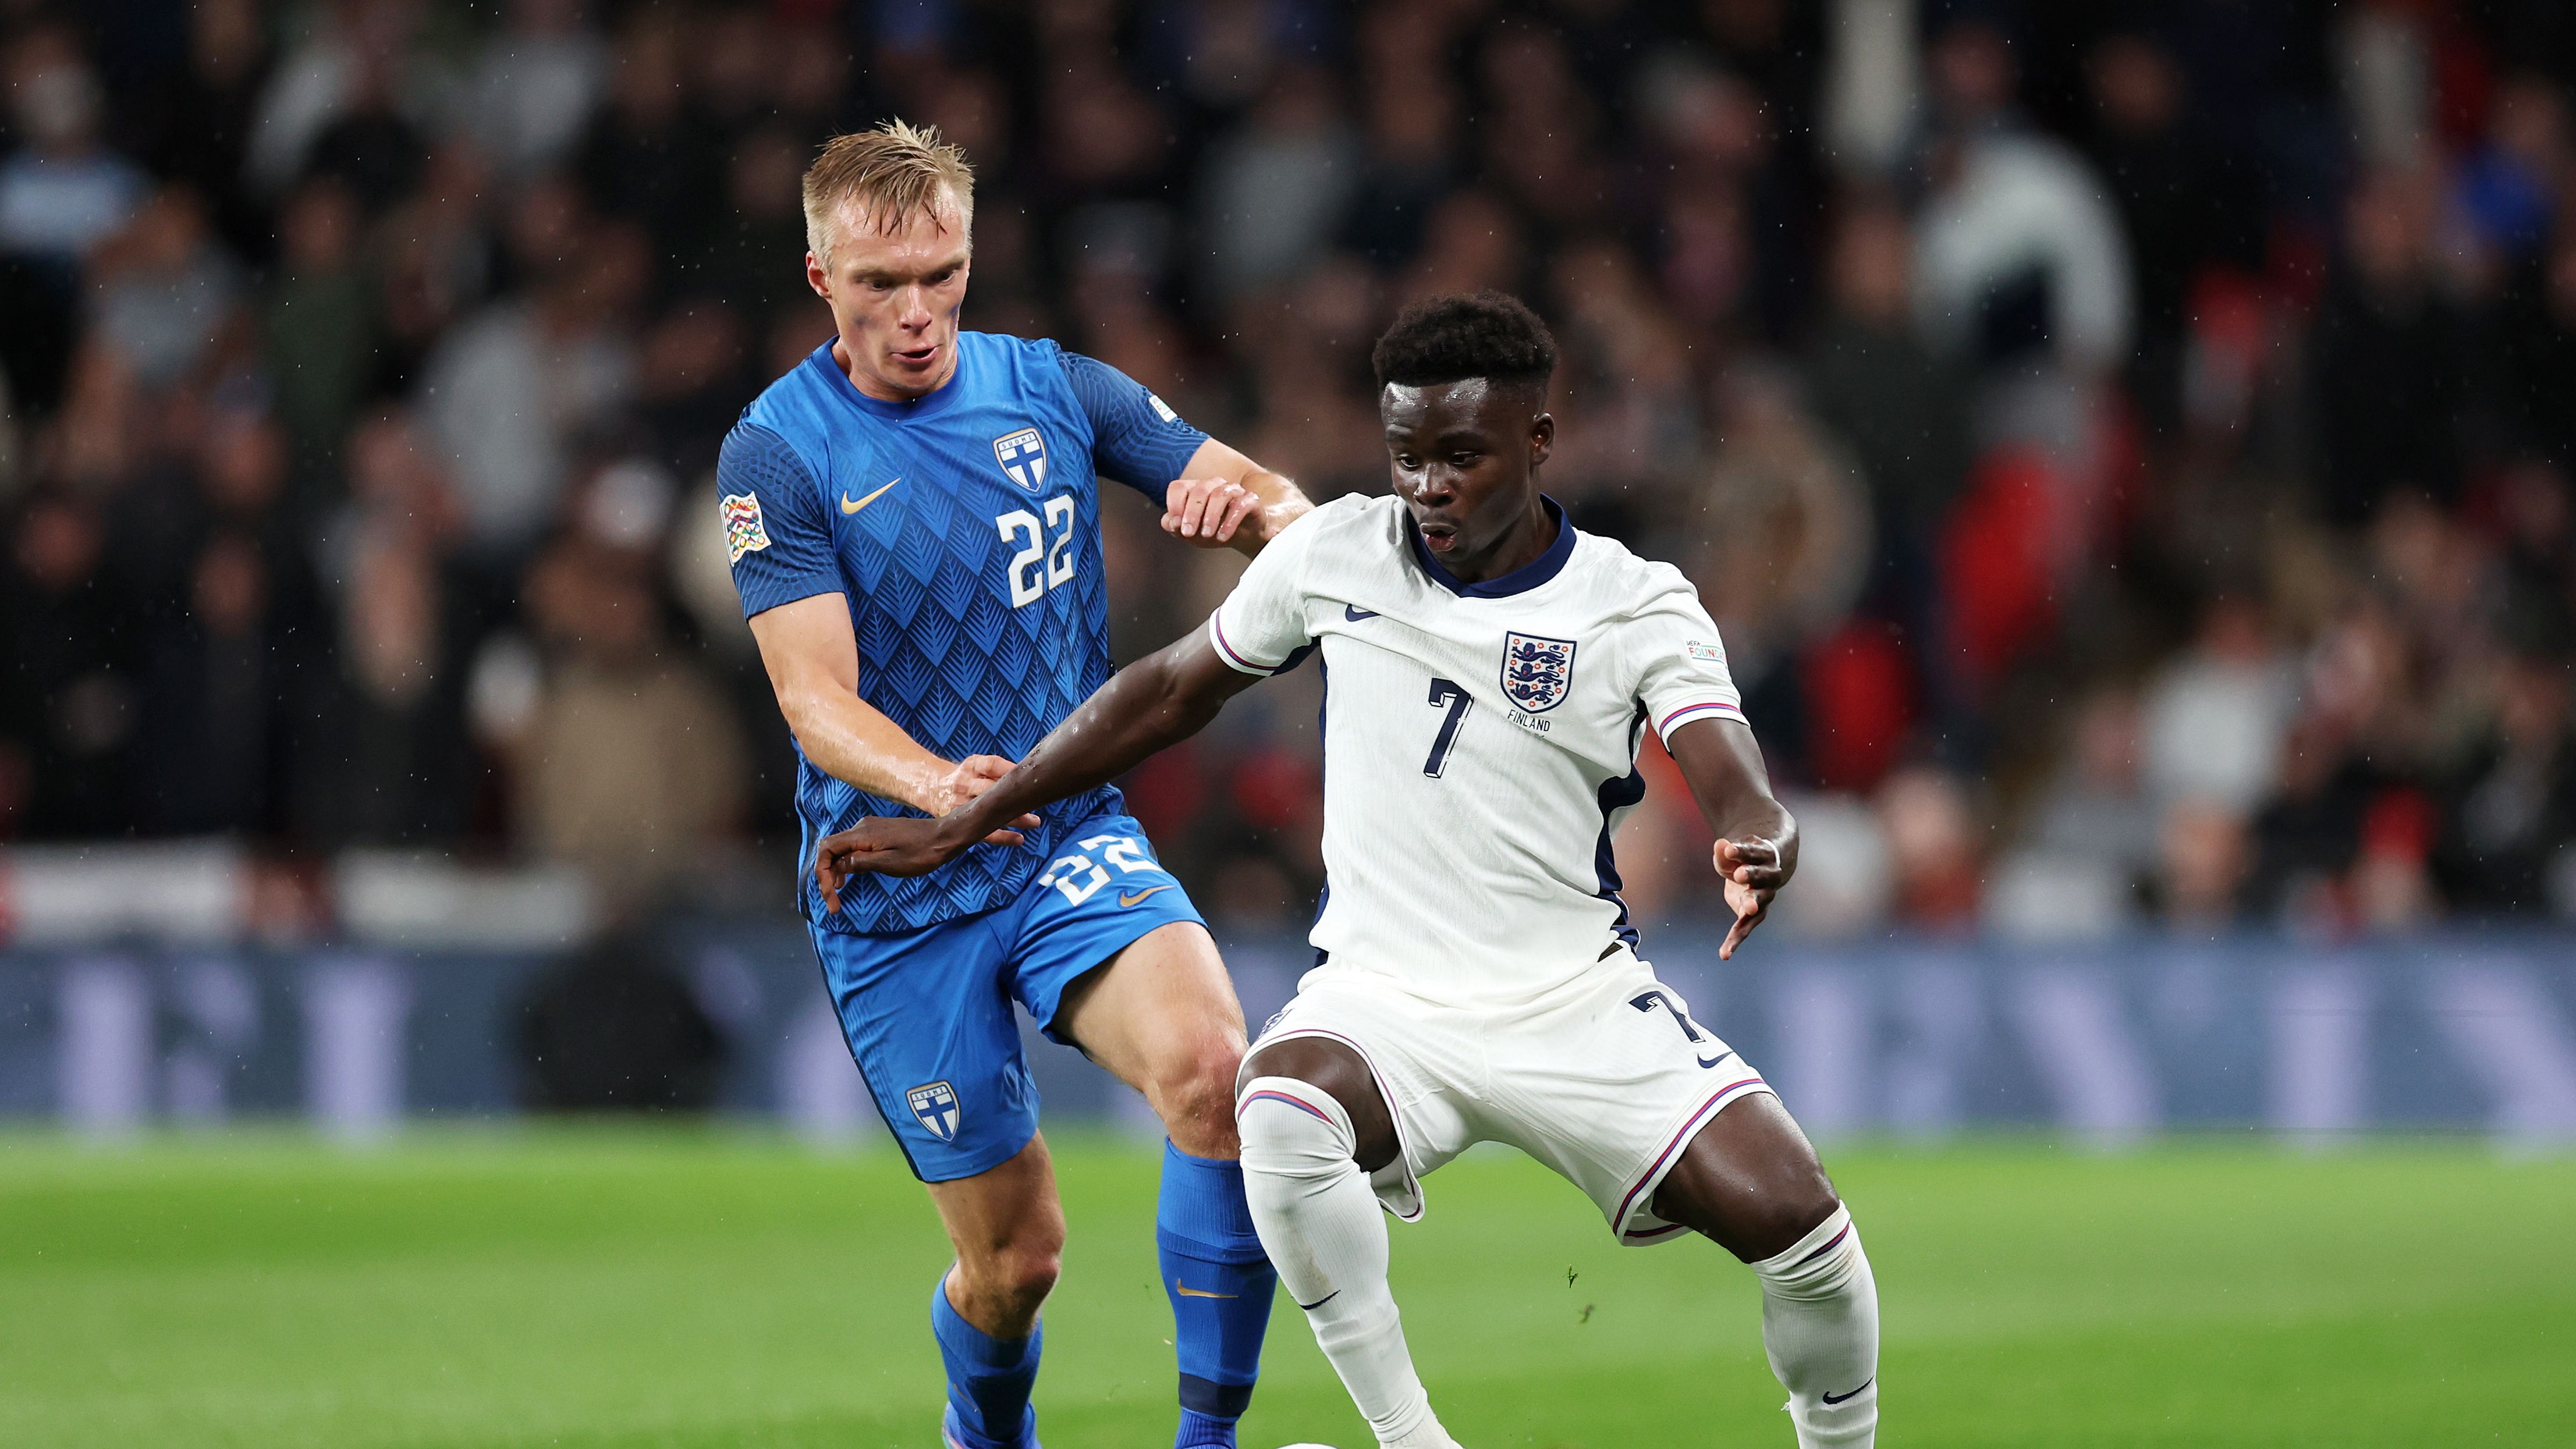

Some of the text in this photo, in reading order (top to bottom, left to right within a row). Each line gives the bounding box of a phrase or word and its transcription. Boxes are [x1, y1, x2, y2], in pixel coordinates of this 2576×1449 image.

[1002, 435, 1032, 449] SUOMI
[995, 493, 1074, 609] 22
[1424, 677, 1474, 779] 7
[1507, 709, 1550, 731] FINLAND
[1038, 834, 1162, 907] 22
[1628, 990, 1706, 1043] 7
[915, 1088, 943, 1100] SUOMI
